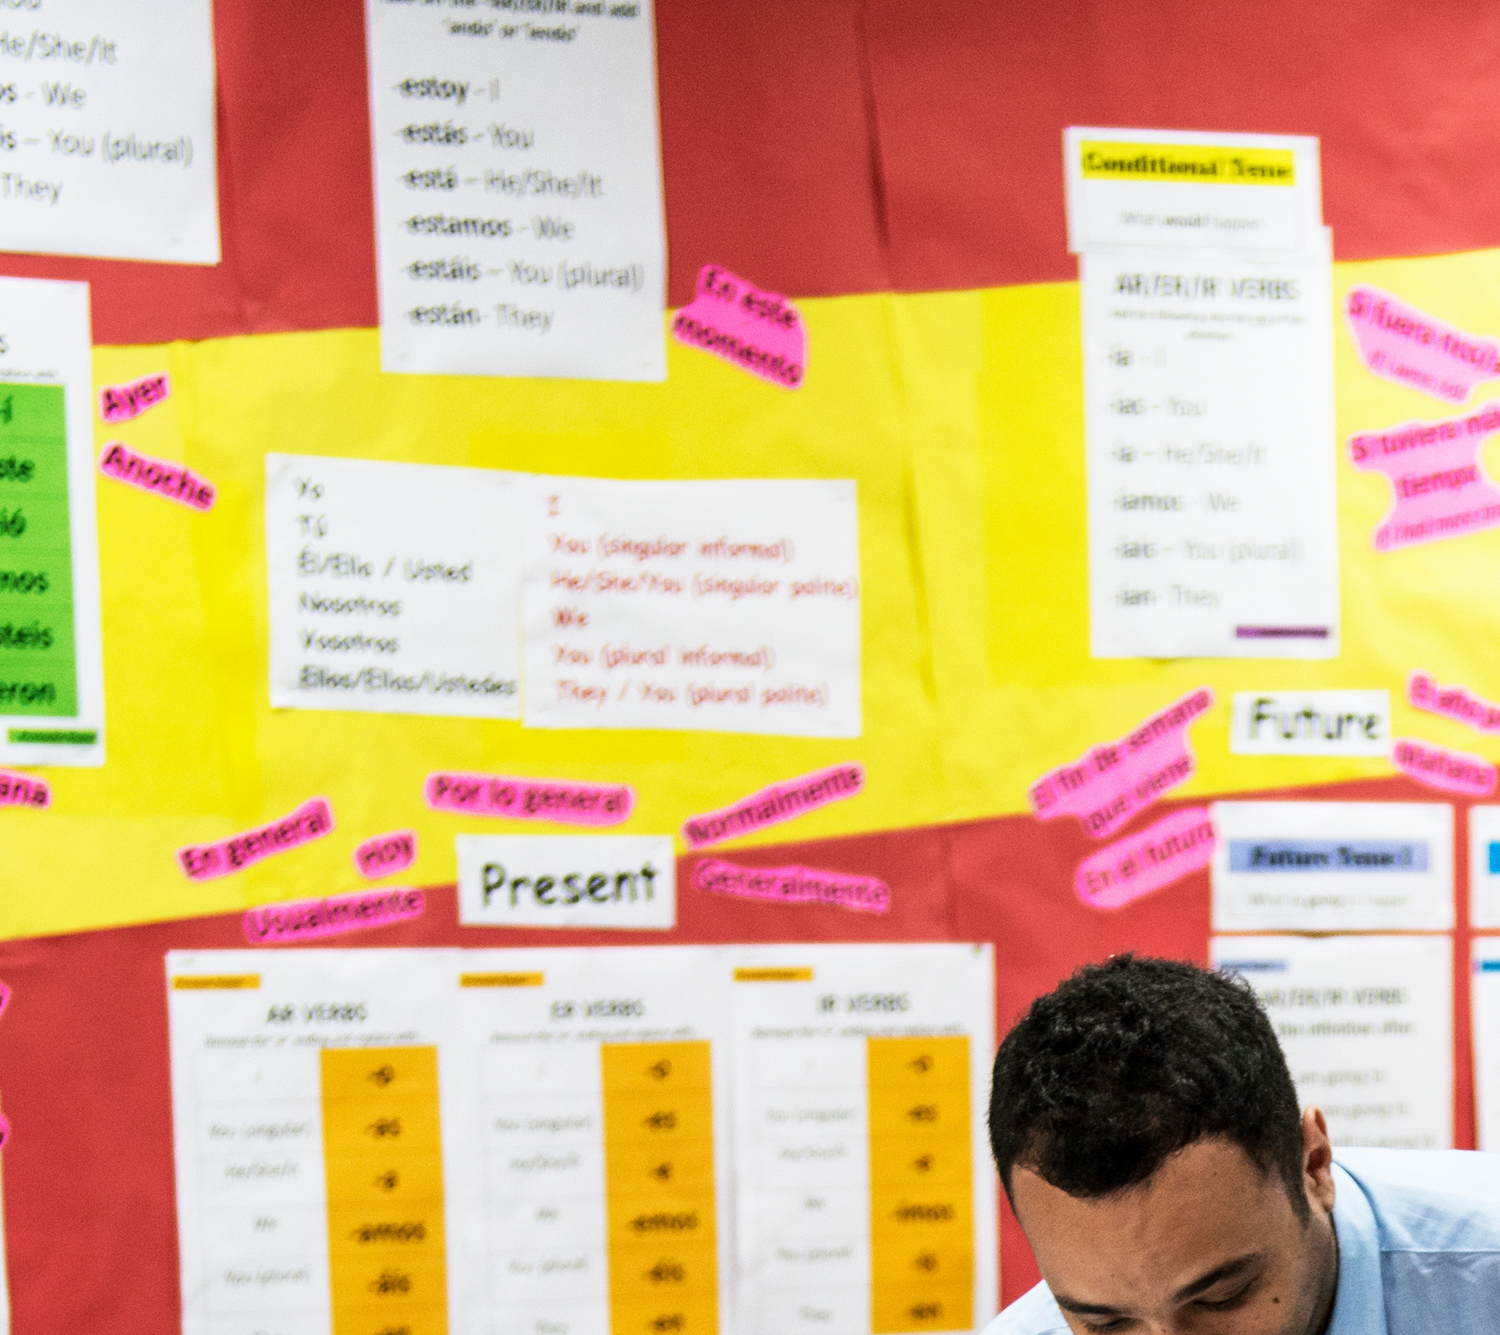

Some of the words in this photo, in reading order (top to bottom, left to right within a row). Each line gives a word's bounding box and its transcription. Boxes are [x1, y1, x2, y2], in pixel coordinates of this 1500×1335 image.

[104, 378, 167, 416] Ayer
[104, 446, 215, 508] Anoche
[1252, 699, 1379, 739] Future
[434, 778, 480, 803] Por
[486, 781, 513, 803] lo
[522, 783, 628, 818] general
[688, 766, 863, 844] Normalmente
[225, 809, 328, 869] general
[480, 859, 658, 909] Present
